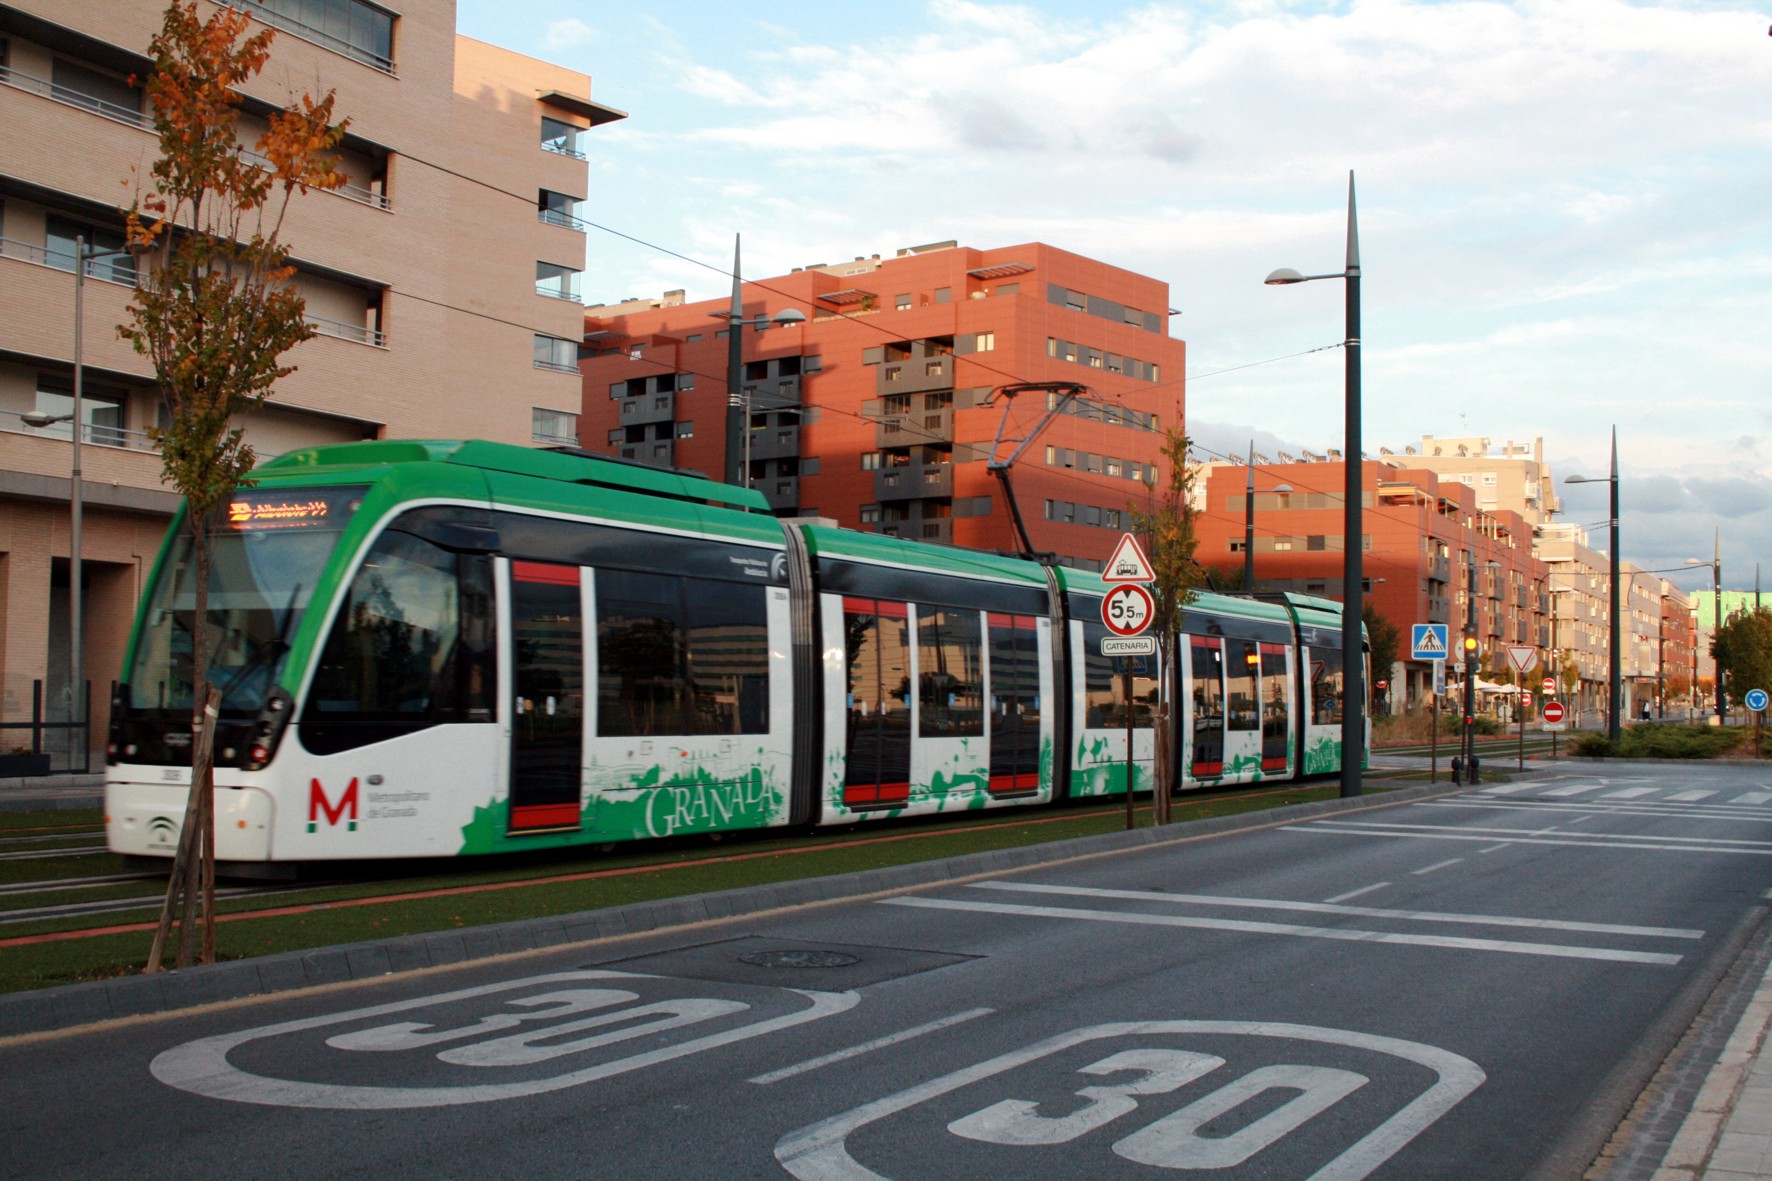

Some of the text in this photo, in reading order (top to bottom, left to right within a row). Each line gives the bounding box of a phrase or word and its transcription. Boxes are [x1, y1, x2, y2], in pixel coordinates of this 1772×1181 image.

[1106, 642, 1149, 650] CATENARIA
[307, 776, 359, 831] M
[645, 765, 777, 838] GRANADA
[324, 989, 751, 1067] 30
[947, 1048, 1370, 1169] 30
